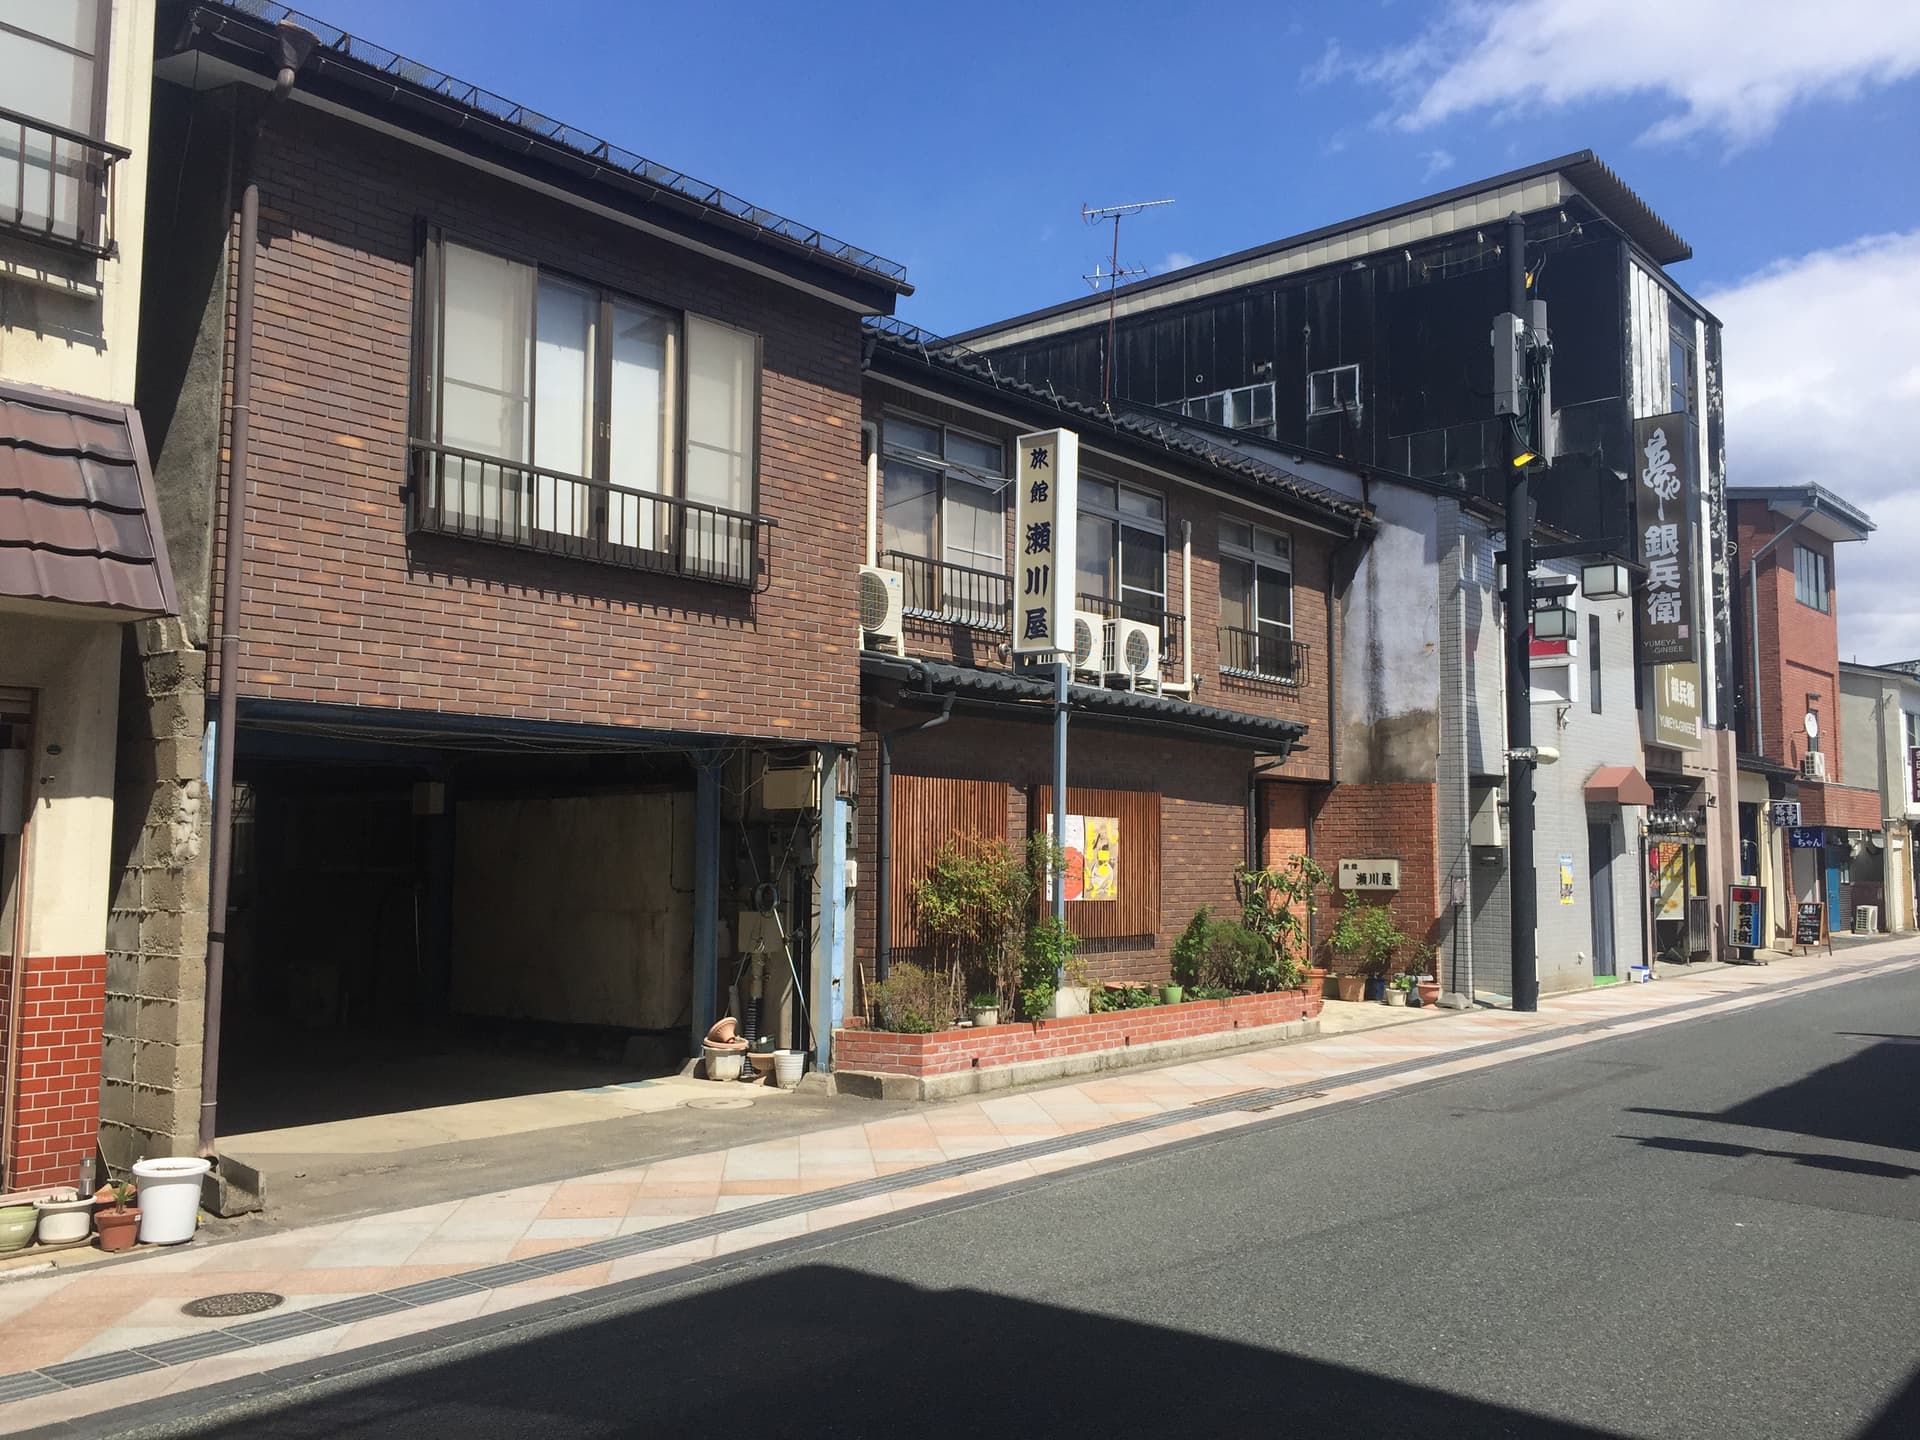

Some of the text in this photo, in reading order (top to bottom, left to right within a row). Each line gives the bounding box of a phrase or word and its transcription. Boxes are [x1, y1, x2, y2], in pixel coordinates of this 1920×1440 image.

[1024, 448, 1051, 641] 旅館 瀬川屋
[1645, 524, 1682, 625] 銀兵衛
[1643, 638, 1677, 648] YUMEYA
[1356, 872, 1392, 886] 瀬川屋
